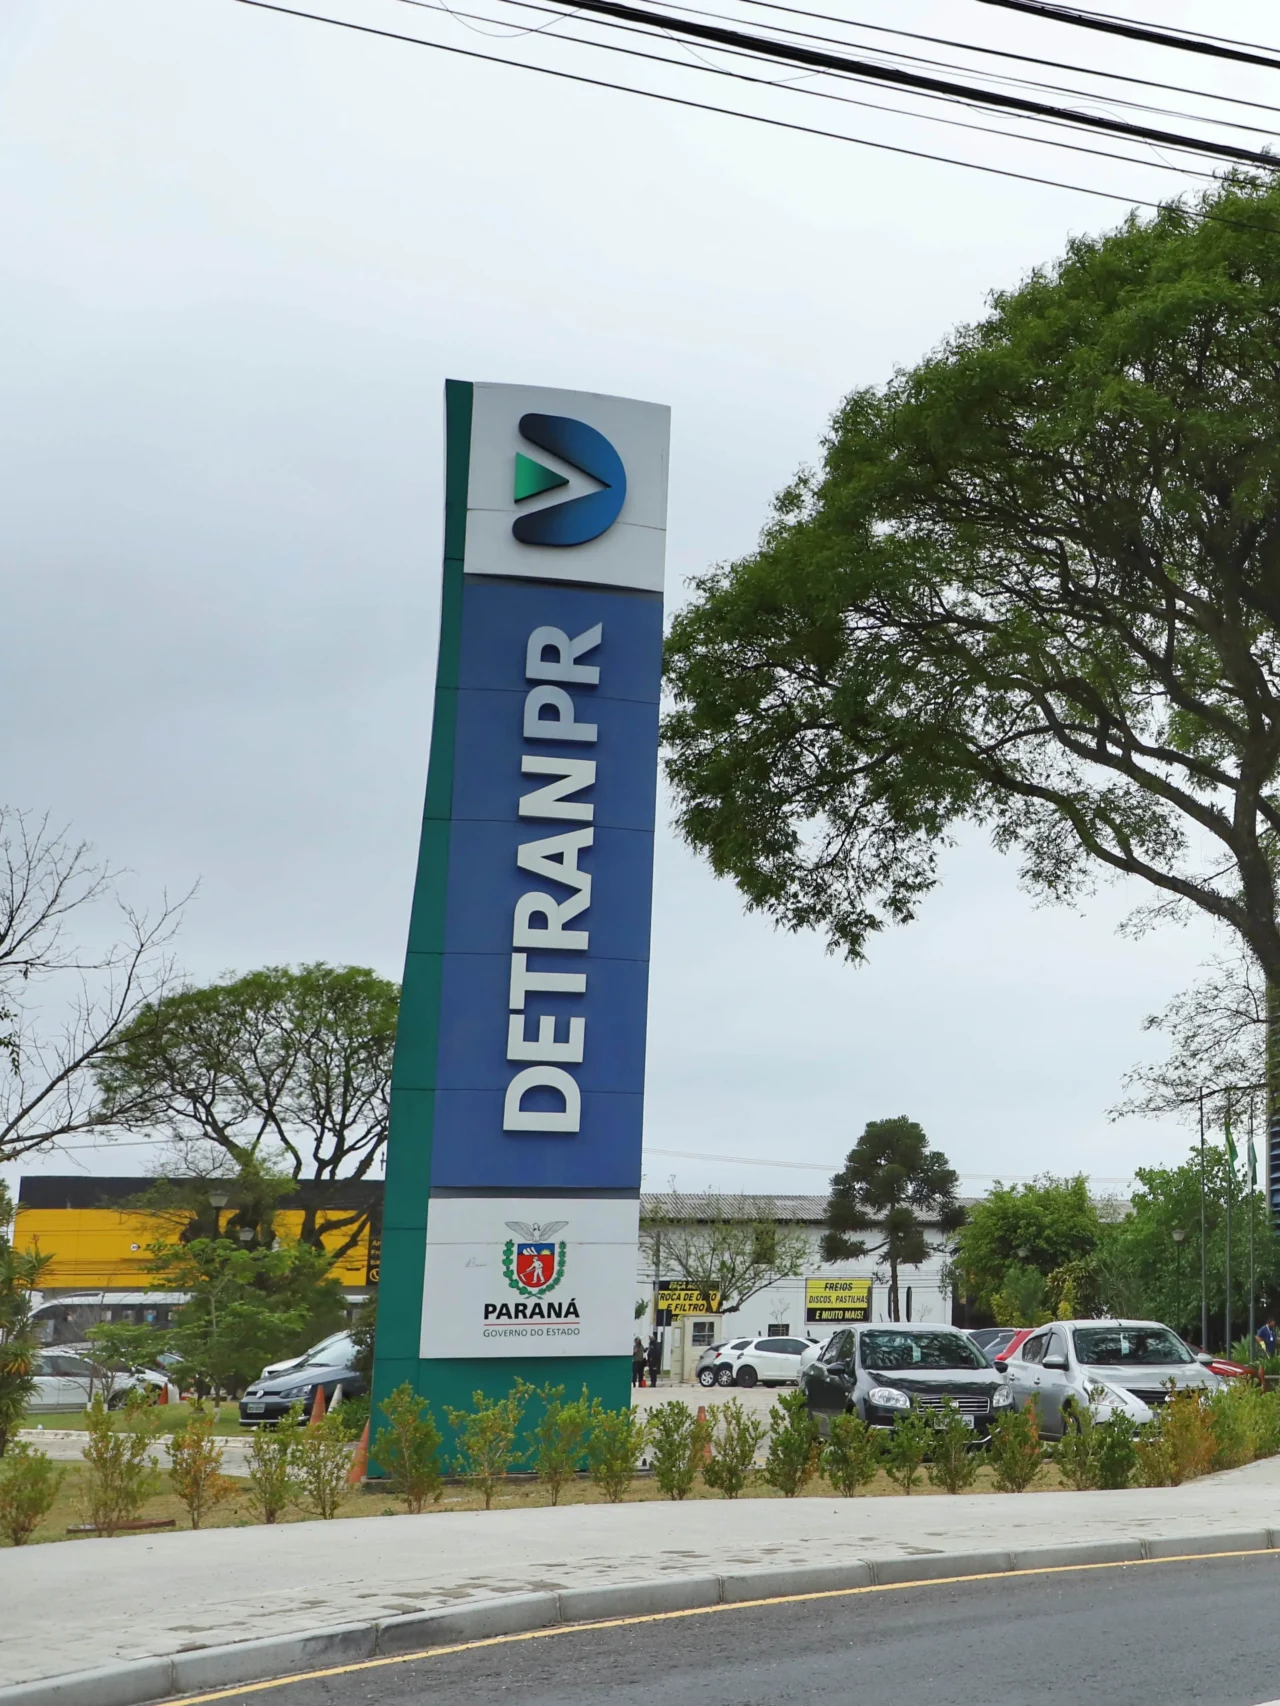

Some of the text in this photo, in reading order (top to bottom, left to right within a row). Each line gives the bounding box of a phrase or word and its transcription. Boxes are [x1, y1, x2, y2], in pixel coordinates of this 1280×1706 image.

[824, 1282, 853, 1292] FREIOS
[683, 1293, 695, 1301] DE
[808, 1295, 868, 1304] DISCOS, PASTILHAS
[484, 1297, 580, 1320] PARANÁ
[673, 1303, 706, 1312] FILTRO
[815, 1310, 865, 1320] E MUITO MAIS!
[483, 1327, 580, 1338] GOVERNO DO ESTADO
